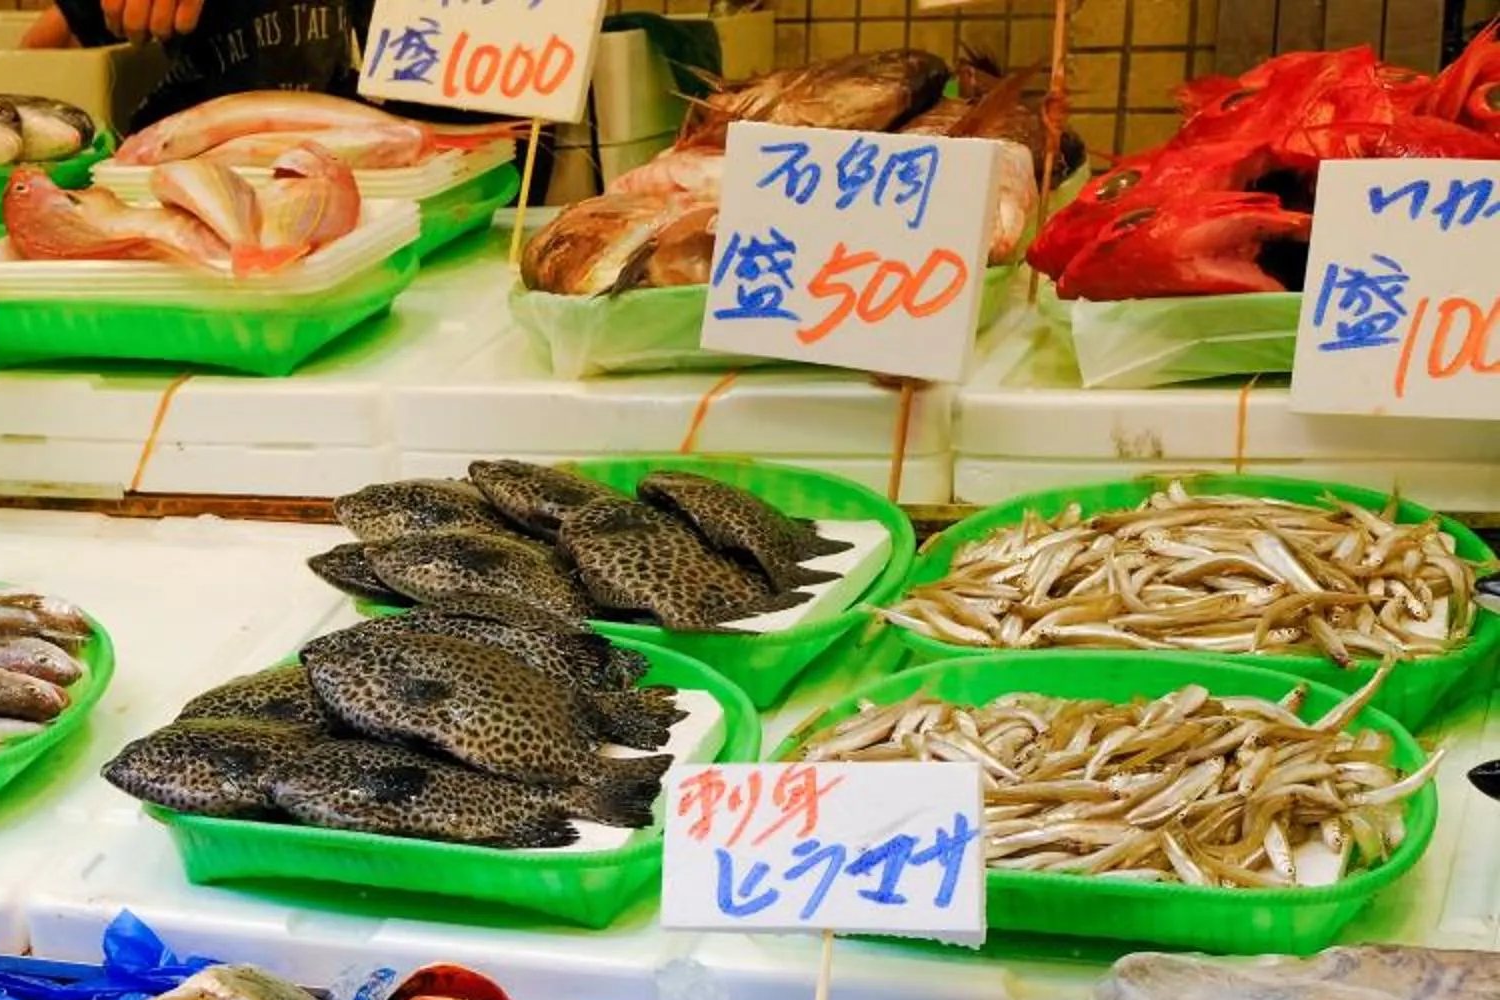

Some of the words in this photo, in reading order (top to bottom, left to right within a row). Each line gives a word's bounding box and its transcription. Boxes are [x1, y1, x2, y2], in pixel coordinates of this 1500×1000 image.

[254, 11, 282, 47] RIS
[442, 31, 575, 98] 1000
[796, 241, 968, 344] 500
